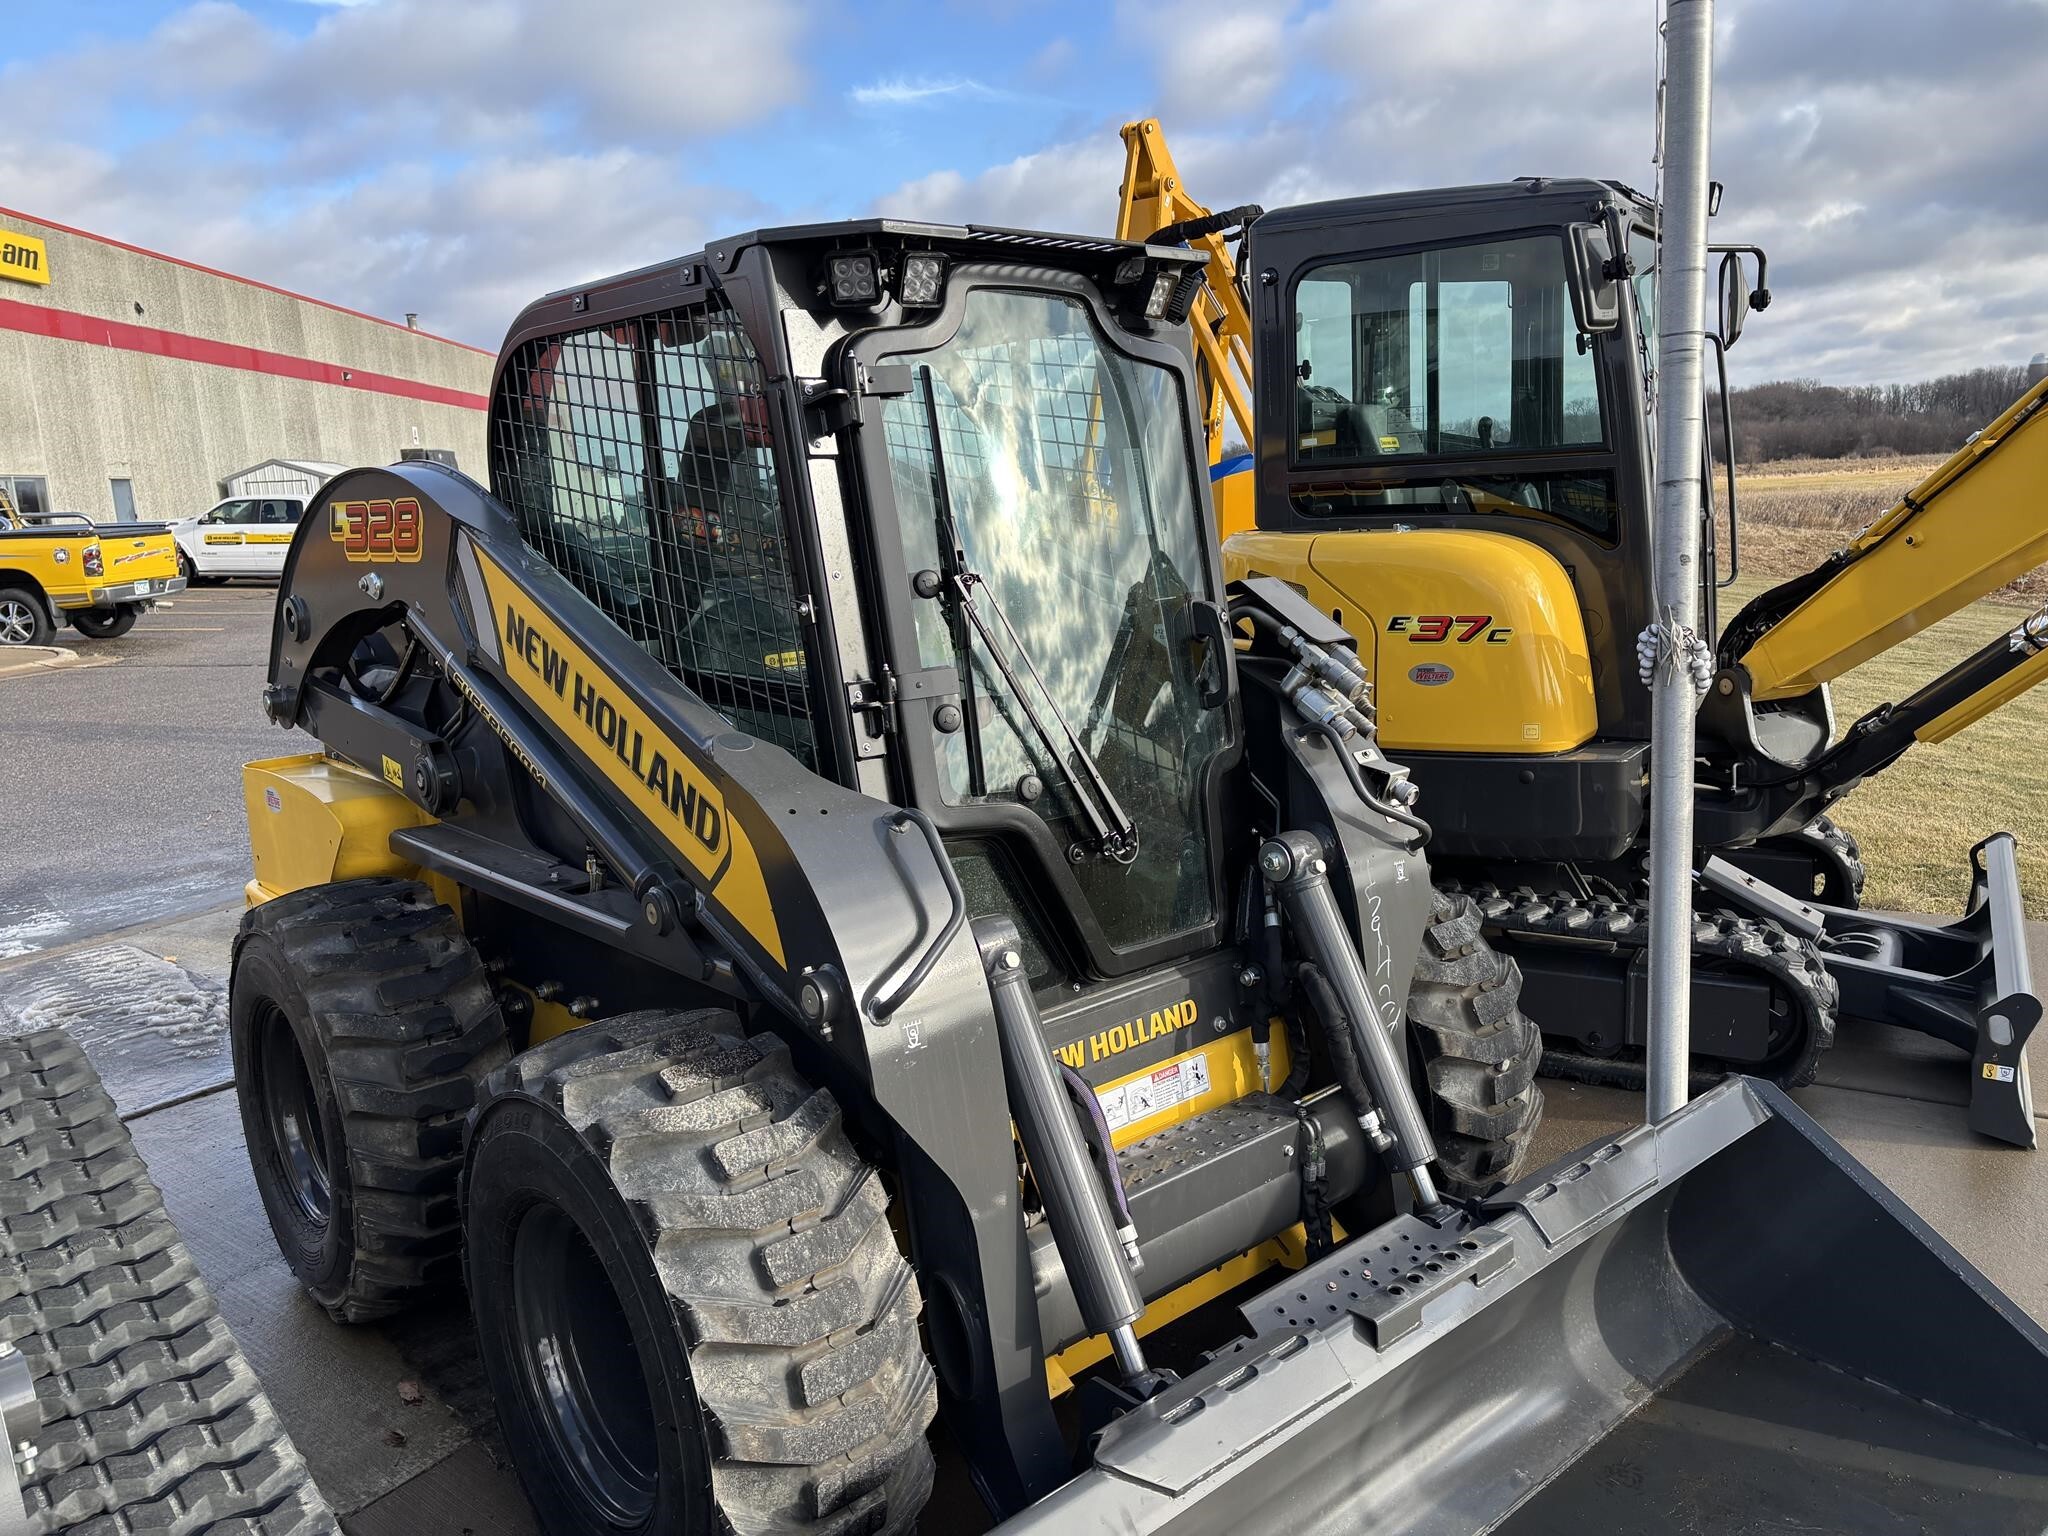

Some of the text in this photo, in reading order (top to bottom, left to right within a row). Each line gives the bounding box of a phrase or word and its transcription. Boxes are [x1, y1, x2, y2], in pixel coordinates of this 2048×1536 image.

[0, 243, 39, 270] am
[329, 498, 423, 562] L328
[506, 603, 723, 854] NEW HOLLAND
[1090, 999, 1198, 1063] HOLLAND
